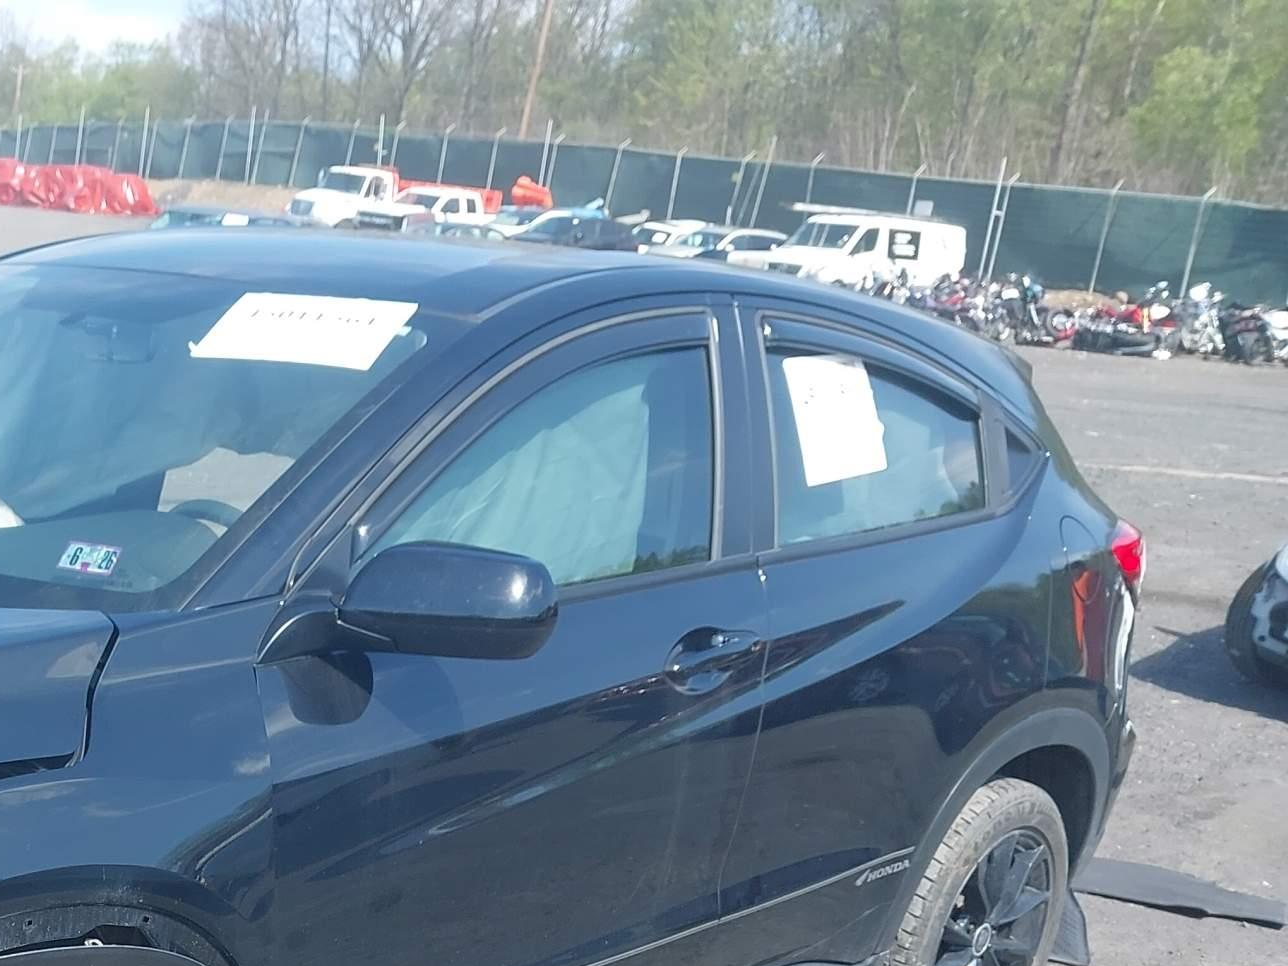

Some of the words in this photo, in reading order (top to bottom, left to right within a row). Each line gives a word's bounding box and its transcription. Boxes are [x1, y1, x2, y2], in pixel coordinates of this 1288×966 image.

[69, 547, 83, 566] 6
[97, 550, 117, 570] 26
[866, 859, 911, 882] HONDA
